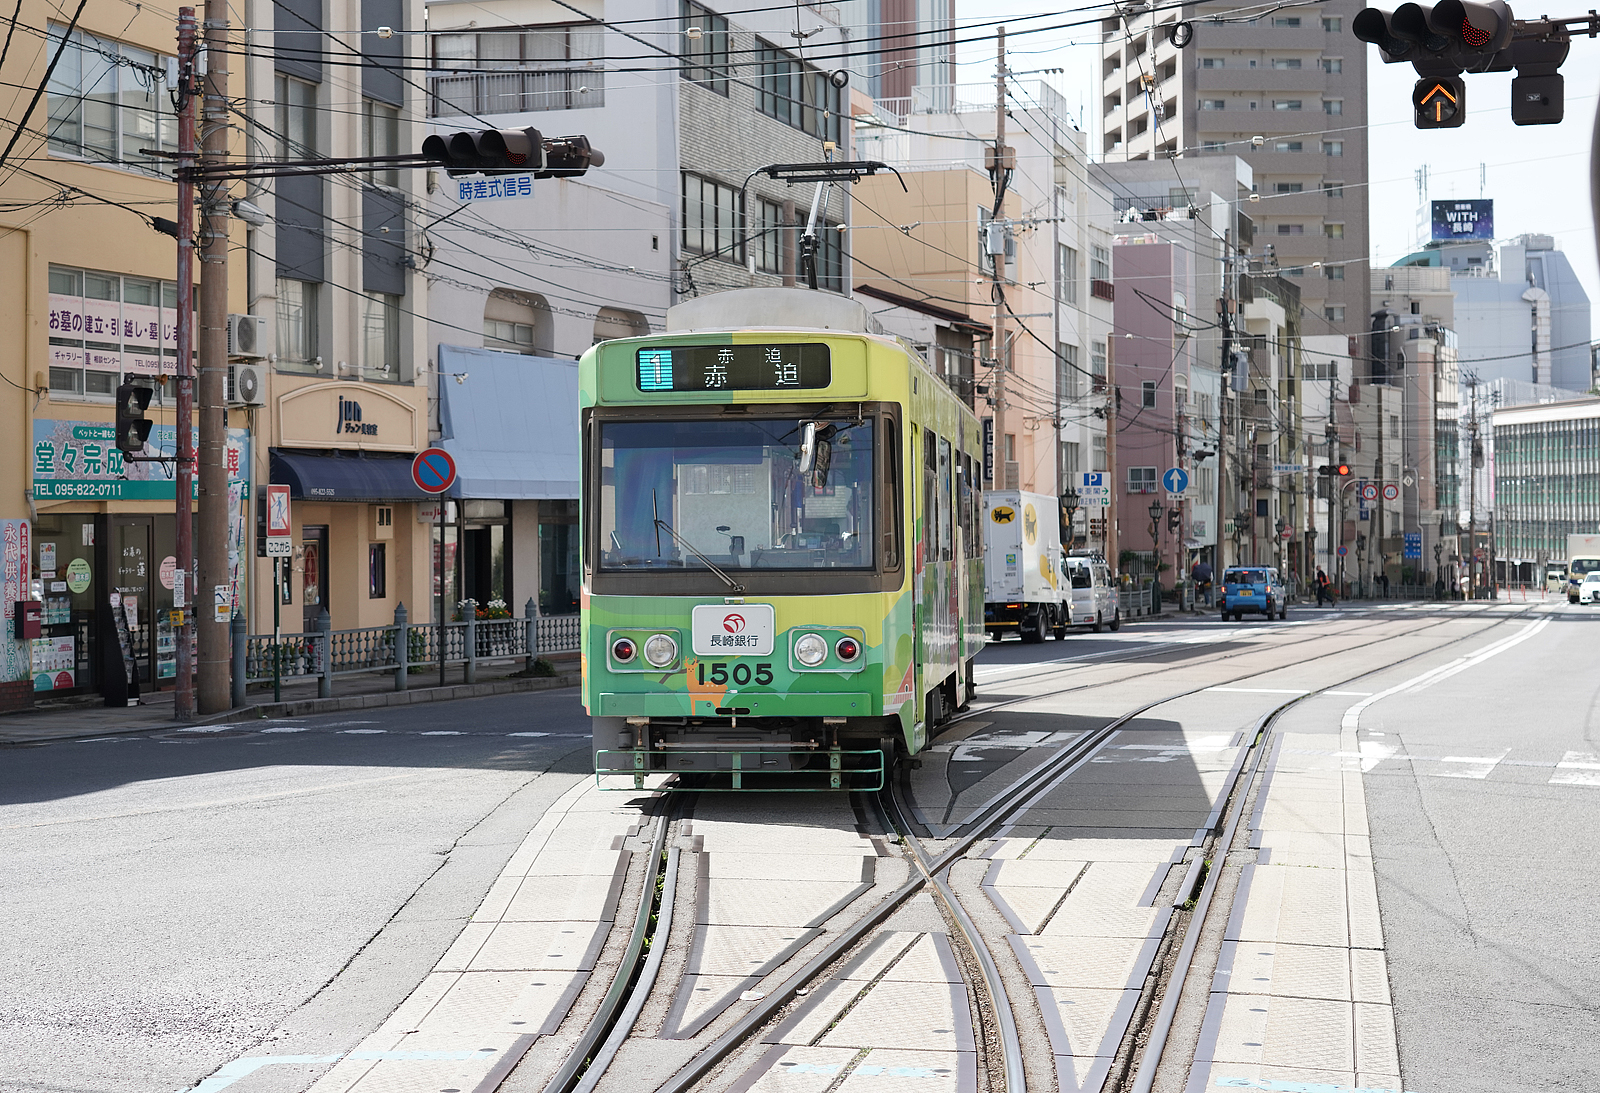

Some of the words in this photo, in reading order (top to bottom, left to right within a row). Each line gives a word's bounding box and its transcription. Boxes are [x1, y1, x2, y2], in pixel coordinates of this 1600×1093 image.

[459, 176, 532, 200] 時差式信号
[1446, 211, 1478, 222] WITH
[55, 351, 82, 361] ギャラリー
[135, 359, 145, 368] TEL
[337, 395, 362, 434] jun
[35, 441, 125, 475] 堂々完成
[1089, 473, 1098, 485] P
[34, 484, 52, 496] TEL
[55, 484, 122, 496] 095-822-0711
[269, 542, 291, 553] ここから
[4, 523, 18, 618] 永代供養墓
[710, 634, 759, 647] 長崎銀行
[698, 663, 774, 686] 1505
